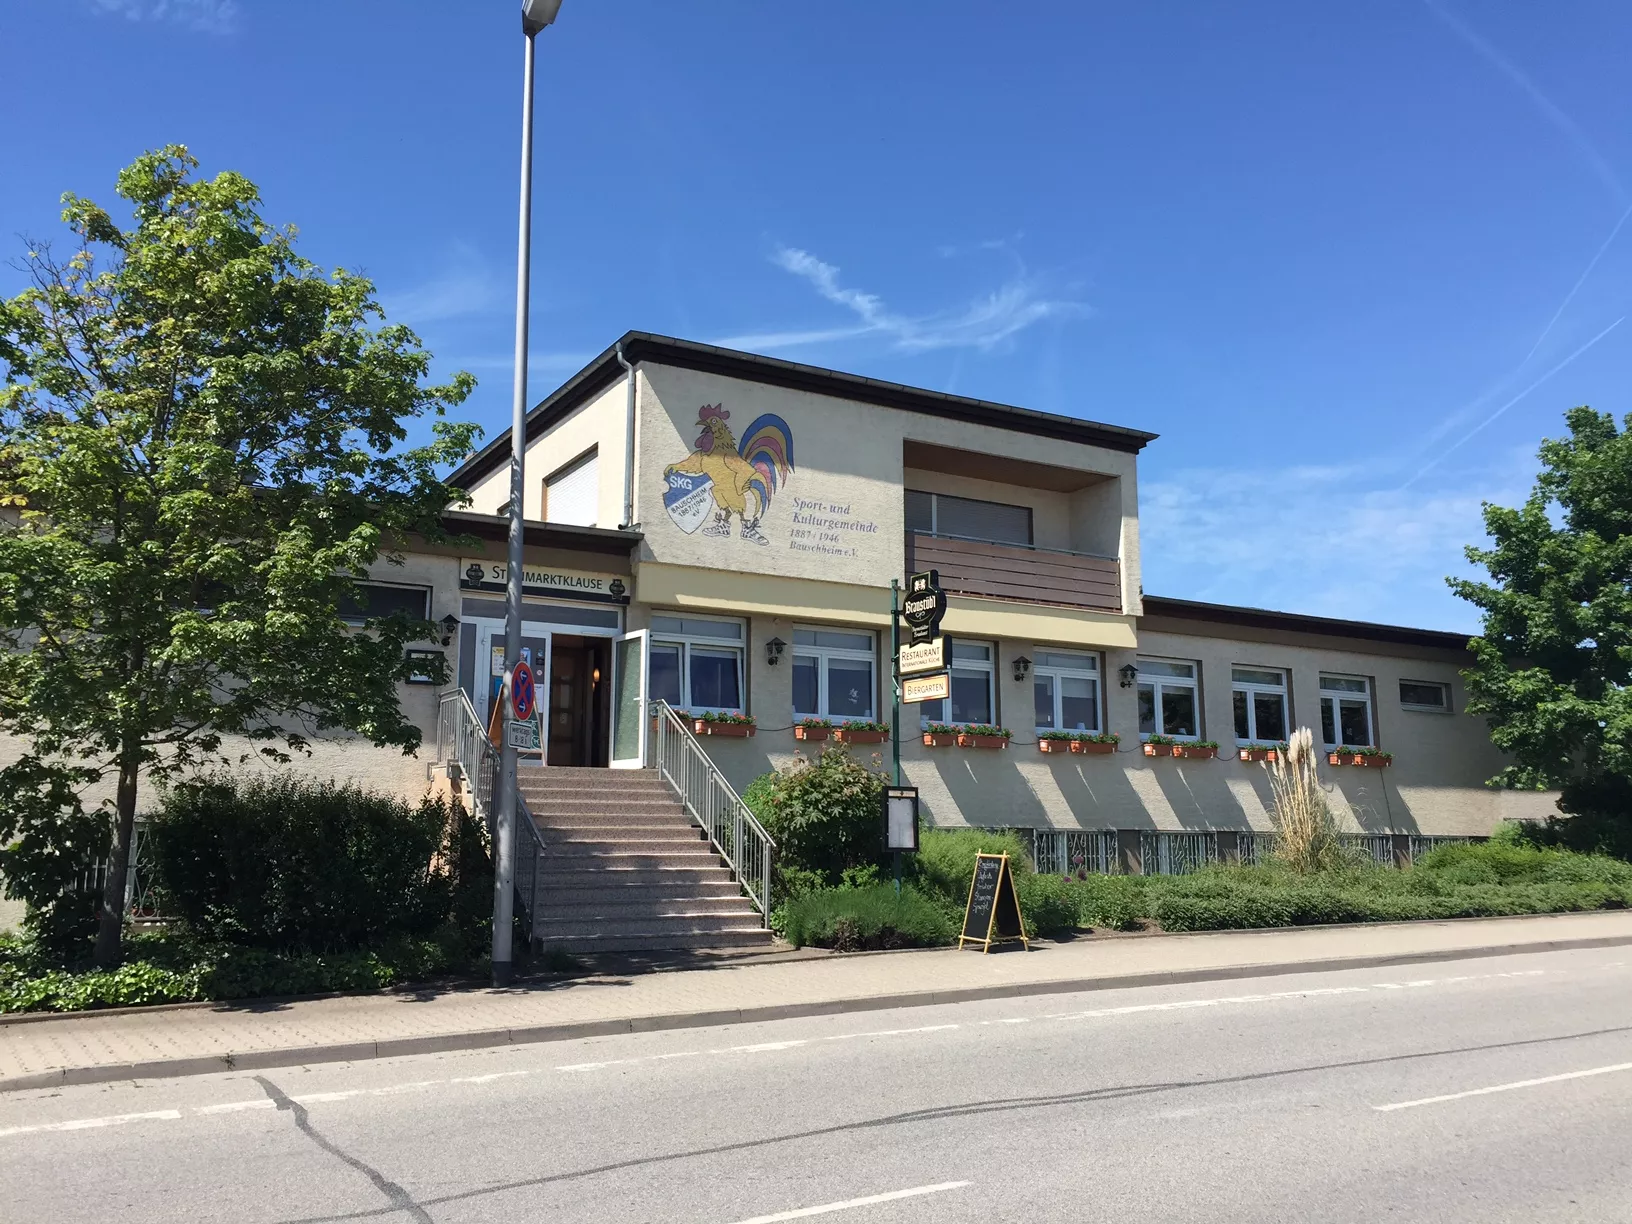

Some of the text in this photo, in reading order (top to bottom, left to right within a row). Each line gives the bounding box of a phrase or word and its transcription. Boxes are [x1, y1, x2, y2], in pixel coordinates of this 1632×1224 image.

[670, 476, 692, 490] SKG
[792, 497, 851, 515] Sport- und
[792, 511, 879, 533] Kulturgemeinde
[789, 541, 842, 556] Bauschheim
[492, 565, 603, 590] STMARKTKLAUSE
[902, 647, 940, 661] RESTAURANT
[908, 683, 943, 695] BIERGARTEN
